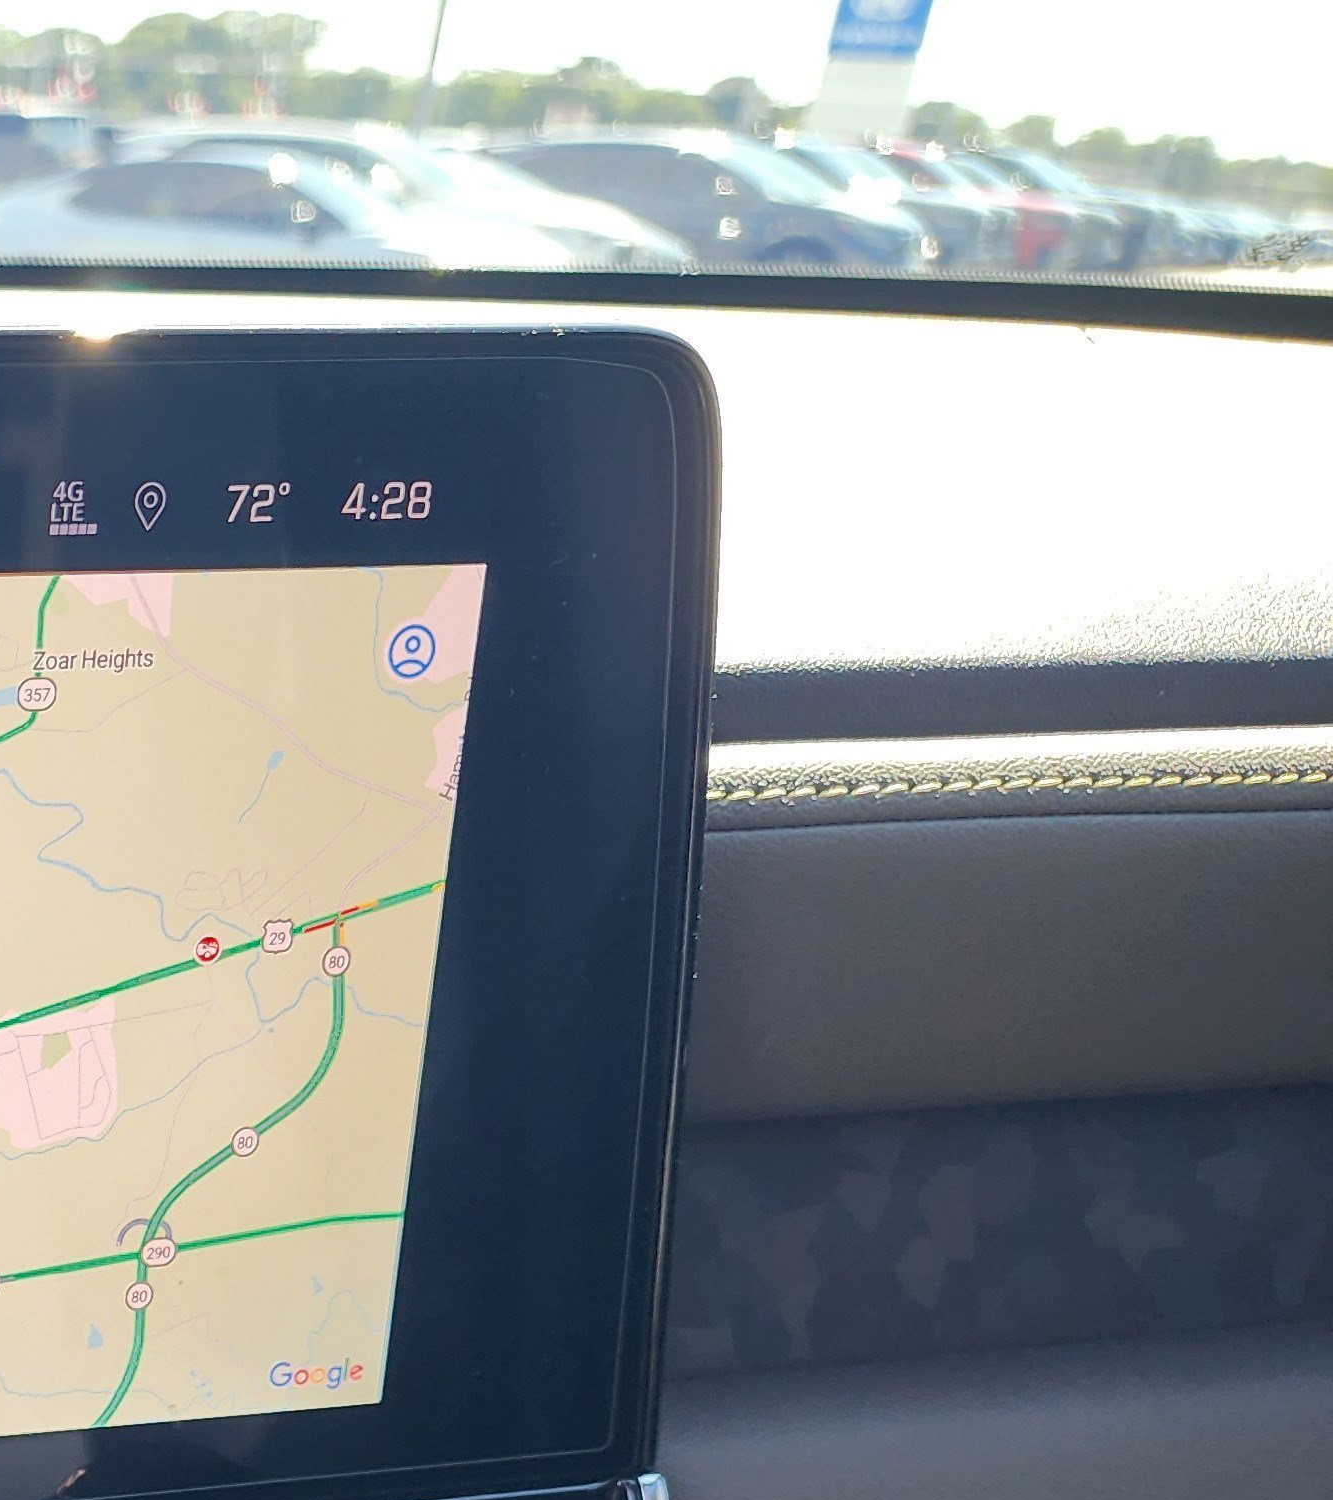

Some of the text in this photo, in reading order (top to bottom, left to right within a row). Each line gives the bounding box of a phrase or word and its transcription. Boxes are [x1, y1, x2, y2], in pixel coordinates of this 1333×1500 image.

[52, 480, 84, 502] 4G
[341, 480, 432, 521] 4:28
[50, 503, 84, 522] LTE
[33, 648, 154, 671] Zoar Heights
[24, 687, 51, 703] 357
[268, 930, 285, 947] 29
[328, 954, 345, 970] 80
[237, 1134, 253, 1150] 80
[145, 1245, 172, 1261] 290
[130, 1289, 147, 1305] 80
[269, 1356, 363, 1390] Google
